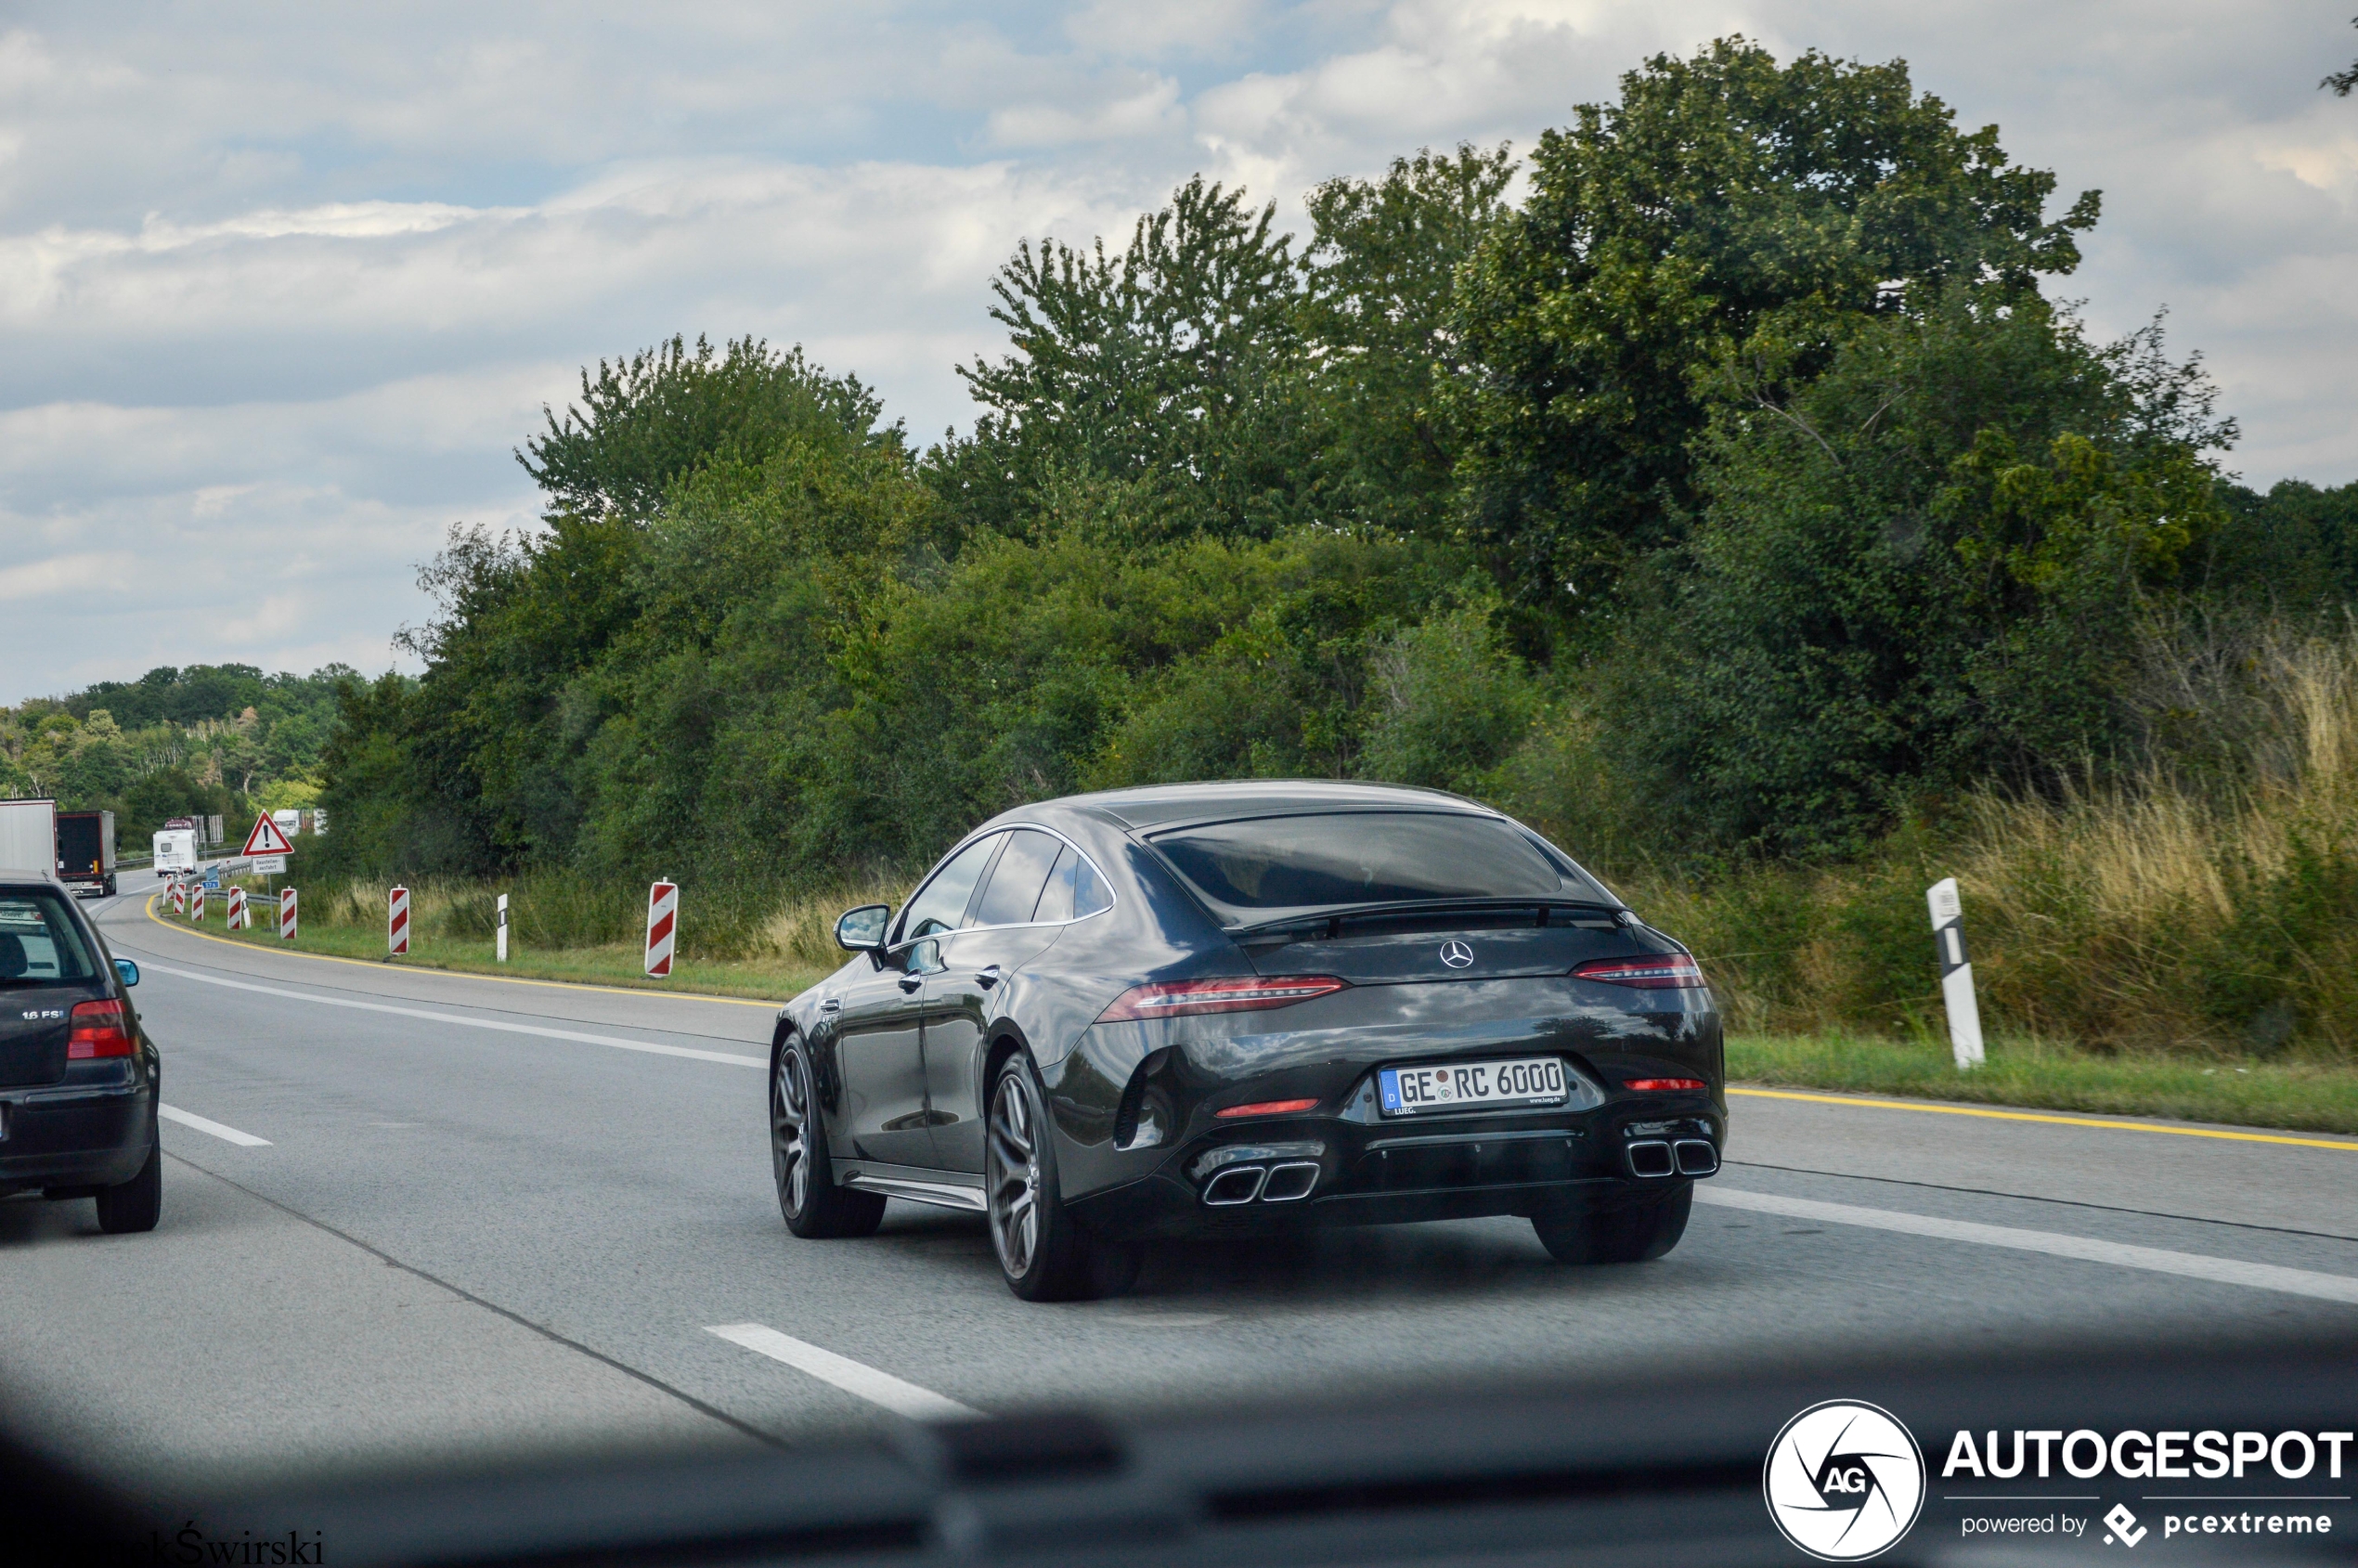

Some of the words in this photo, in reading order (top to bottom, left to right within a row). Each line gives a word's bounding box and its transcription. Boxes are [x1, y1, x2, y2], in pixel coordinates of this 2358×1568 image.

[41, 1010, 64, 1019] FSI
[1400, 1071, 1435, 1103] GE
[1454, 1067, 1489, 1098] RC
[1496, 1062, 1561, 1095] 6000
[1389, 1094, 1395, 1103] D
